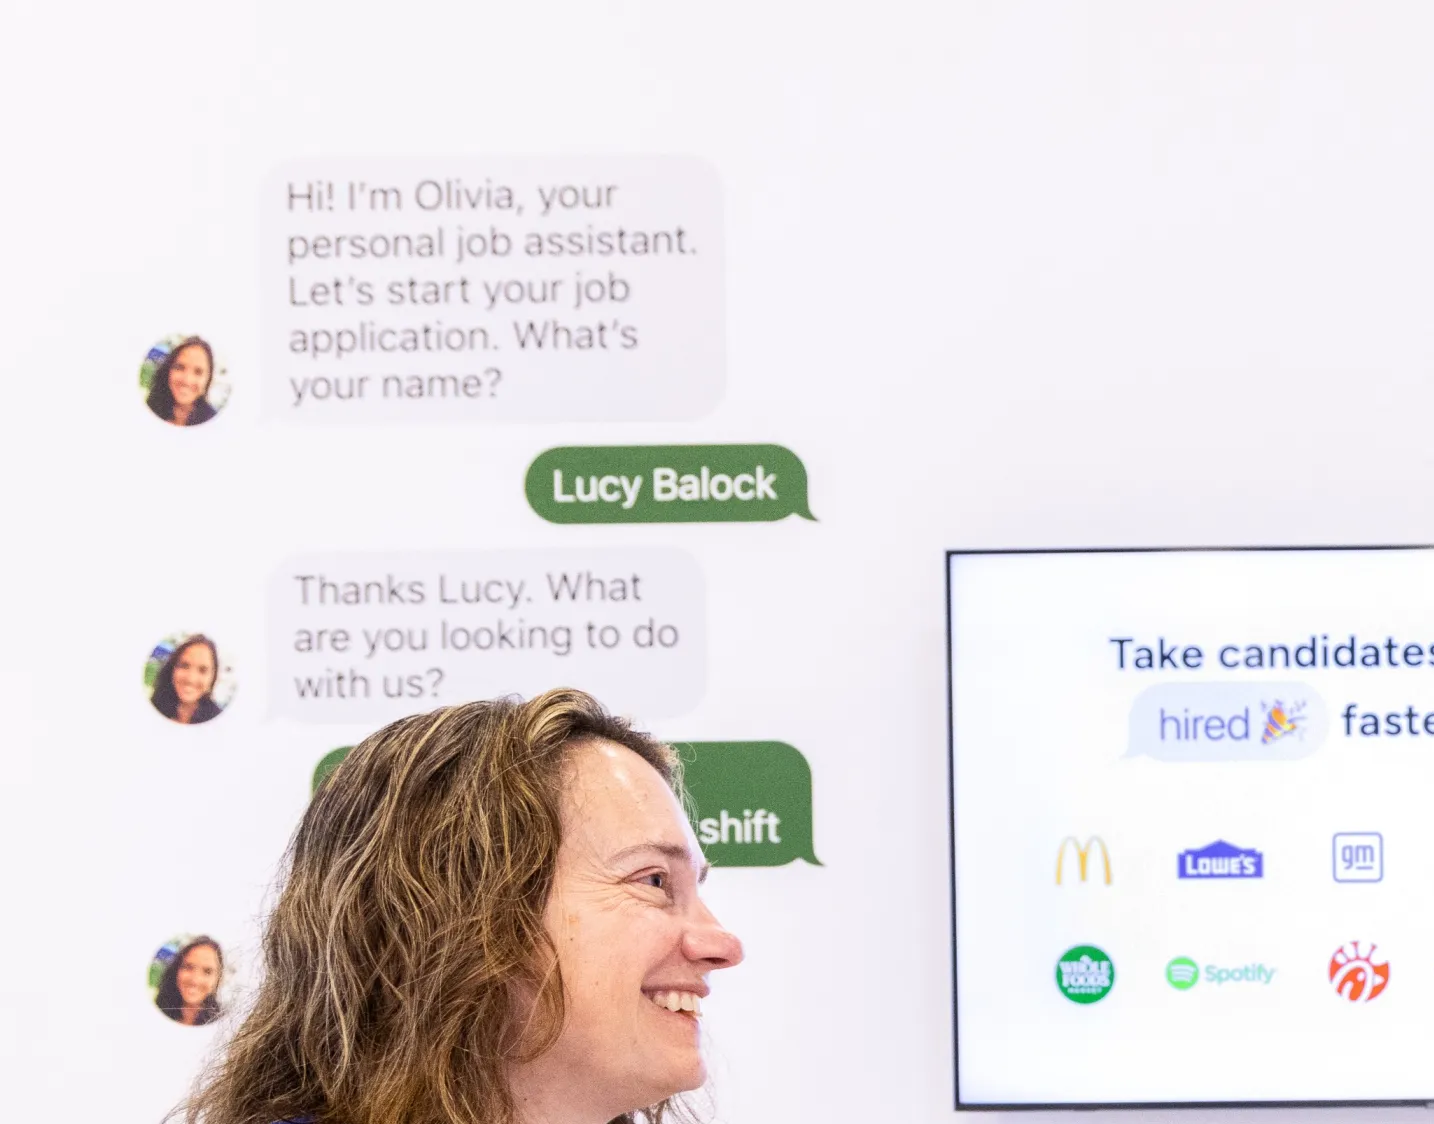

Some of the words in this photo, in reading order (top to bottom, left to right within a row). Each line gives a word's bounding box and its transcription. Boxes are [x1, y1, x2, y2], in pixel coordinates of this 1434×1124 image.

[288, 181, 333, 211] Hi!
[349, 182, 402, 210] I'm
[415, 179, 523, 215] Olivia,
[538, 185, 617, 216] your
[288, 227, 444, 265] personal
[457, 227, 512, 263] job
[525, 227, 696, 256] assistant.
[290, 276, 374, 306] Let's
[388, 277, 469, 304] start
[484, 280, 562, 310] your
[575, 272, 630, 309] job
[289, 321, 498, 358] application.
[514, 320, 637, 349] What's
[290, 376, 370, 407] your
[383, 367, 502, 399] name?
[552, 470, 641, 508] Lucy
[654, 467, 777, 502] Balock
[295, 575, 425, 605] Thanks
[439, 575, 532, 610] Lucy.
[547, 572, 641, 601] What
[295, 629, 350, 652] are
[363, 628, 428, 659] you
[442, 619, 572, 656] looking
[586, 622, 620, 649] to
[633, 618, 679, 648] do
[1110, 639, 1203, 669] Take
[295, 669, 369, 699] with
[383, 668, 445, 698] us?
[1160, 707, 1249, 741] hired
[700, 809, 780, 844] shift
[1205, 963, 1275, 984] Spotify
